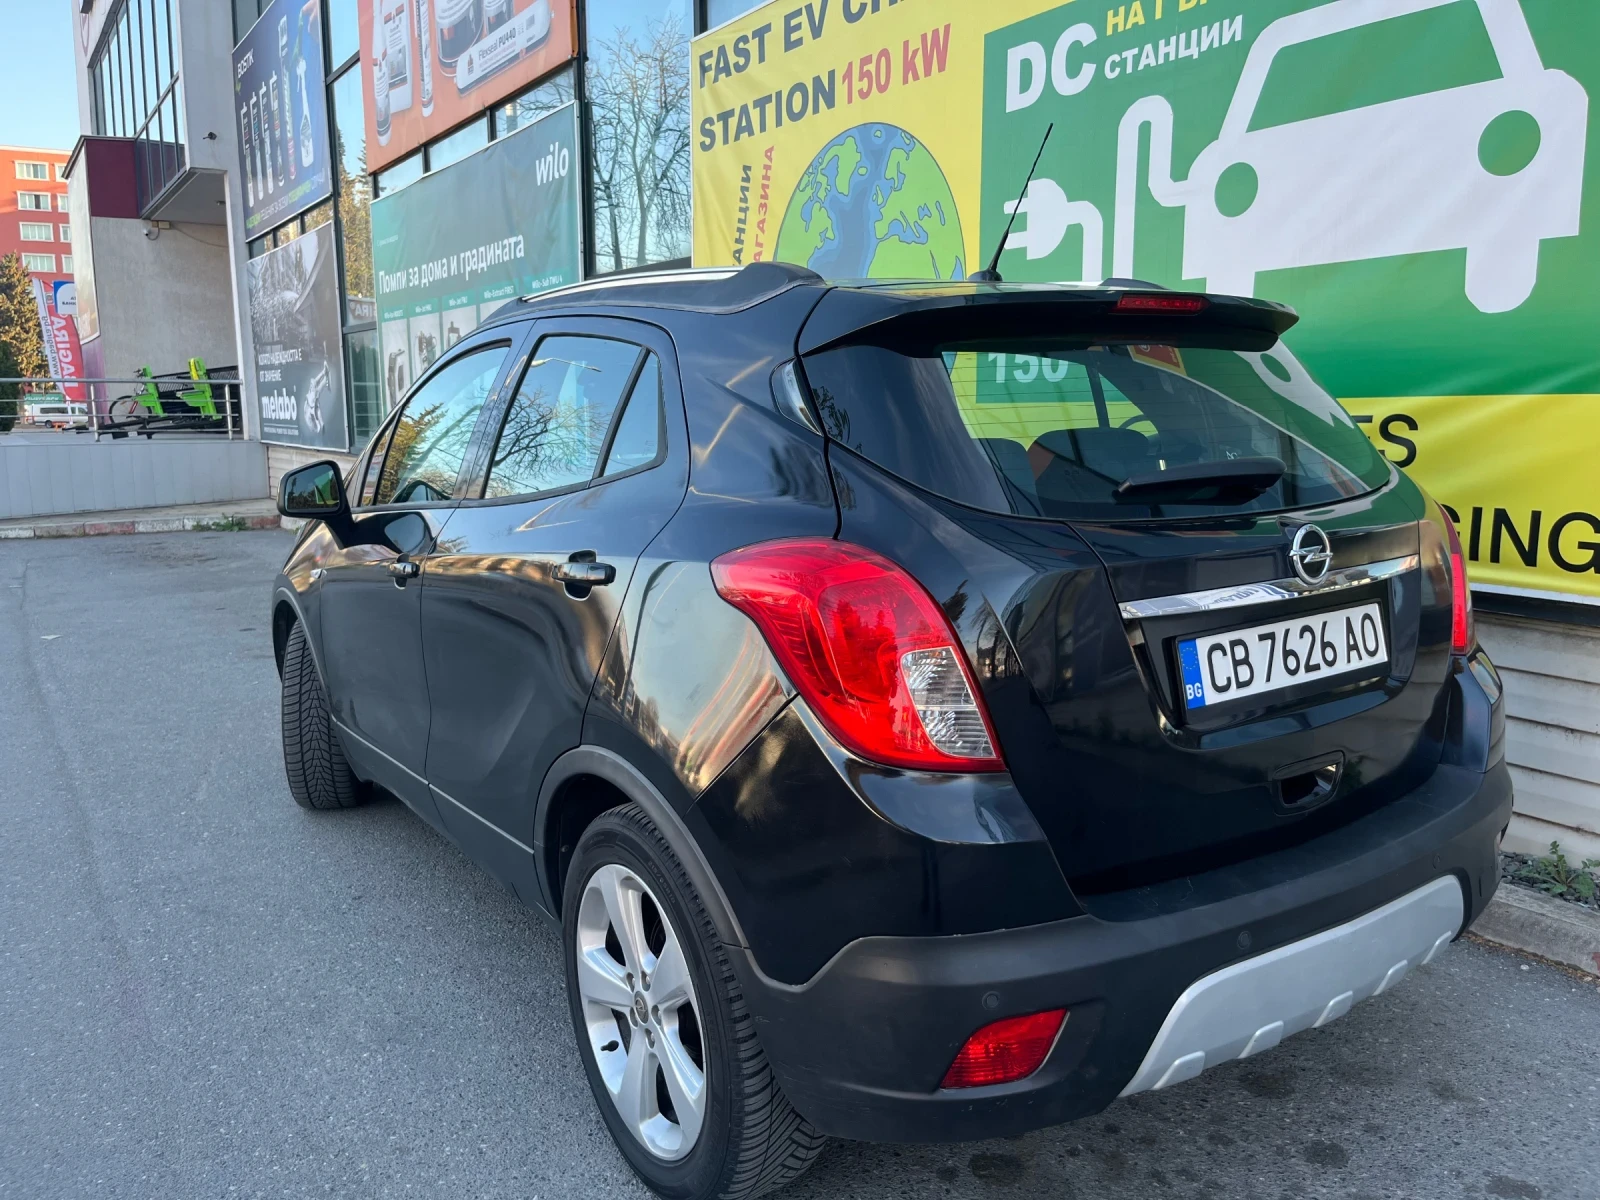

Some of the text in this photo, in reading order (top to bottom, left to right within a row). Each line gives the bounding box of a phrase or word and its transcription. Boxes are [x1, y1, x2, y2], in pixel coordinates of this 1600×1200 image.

[699, 22, 772, 88] FAST
[784, 0, 828, 52] EV
[1104, 14, 1243, 80] СТАНЦИИ
[1106, 0, 1146, 36] НА
[238, 48, 254, 78] BOSTIK
[700, 23, 951, 152] STATION 150 kW
[1006, 22, 1098, 113] DC
[536, 142, 569, 186] wilo
[732, 164, 752, 266] АНЦИИ
[378, 234, 525, 294] Помпи за дома и градината
[988, 353, 1068, 383] 150
[1206, 612, 1380, 694] CB 7626 AO
[1186, 683, 1202, 700] BG
